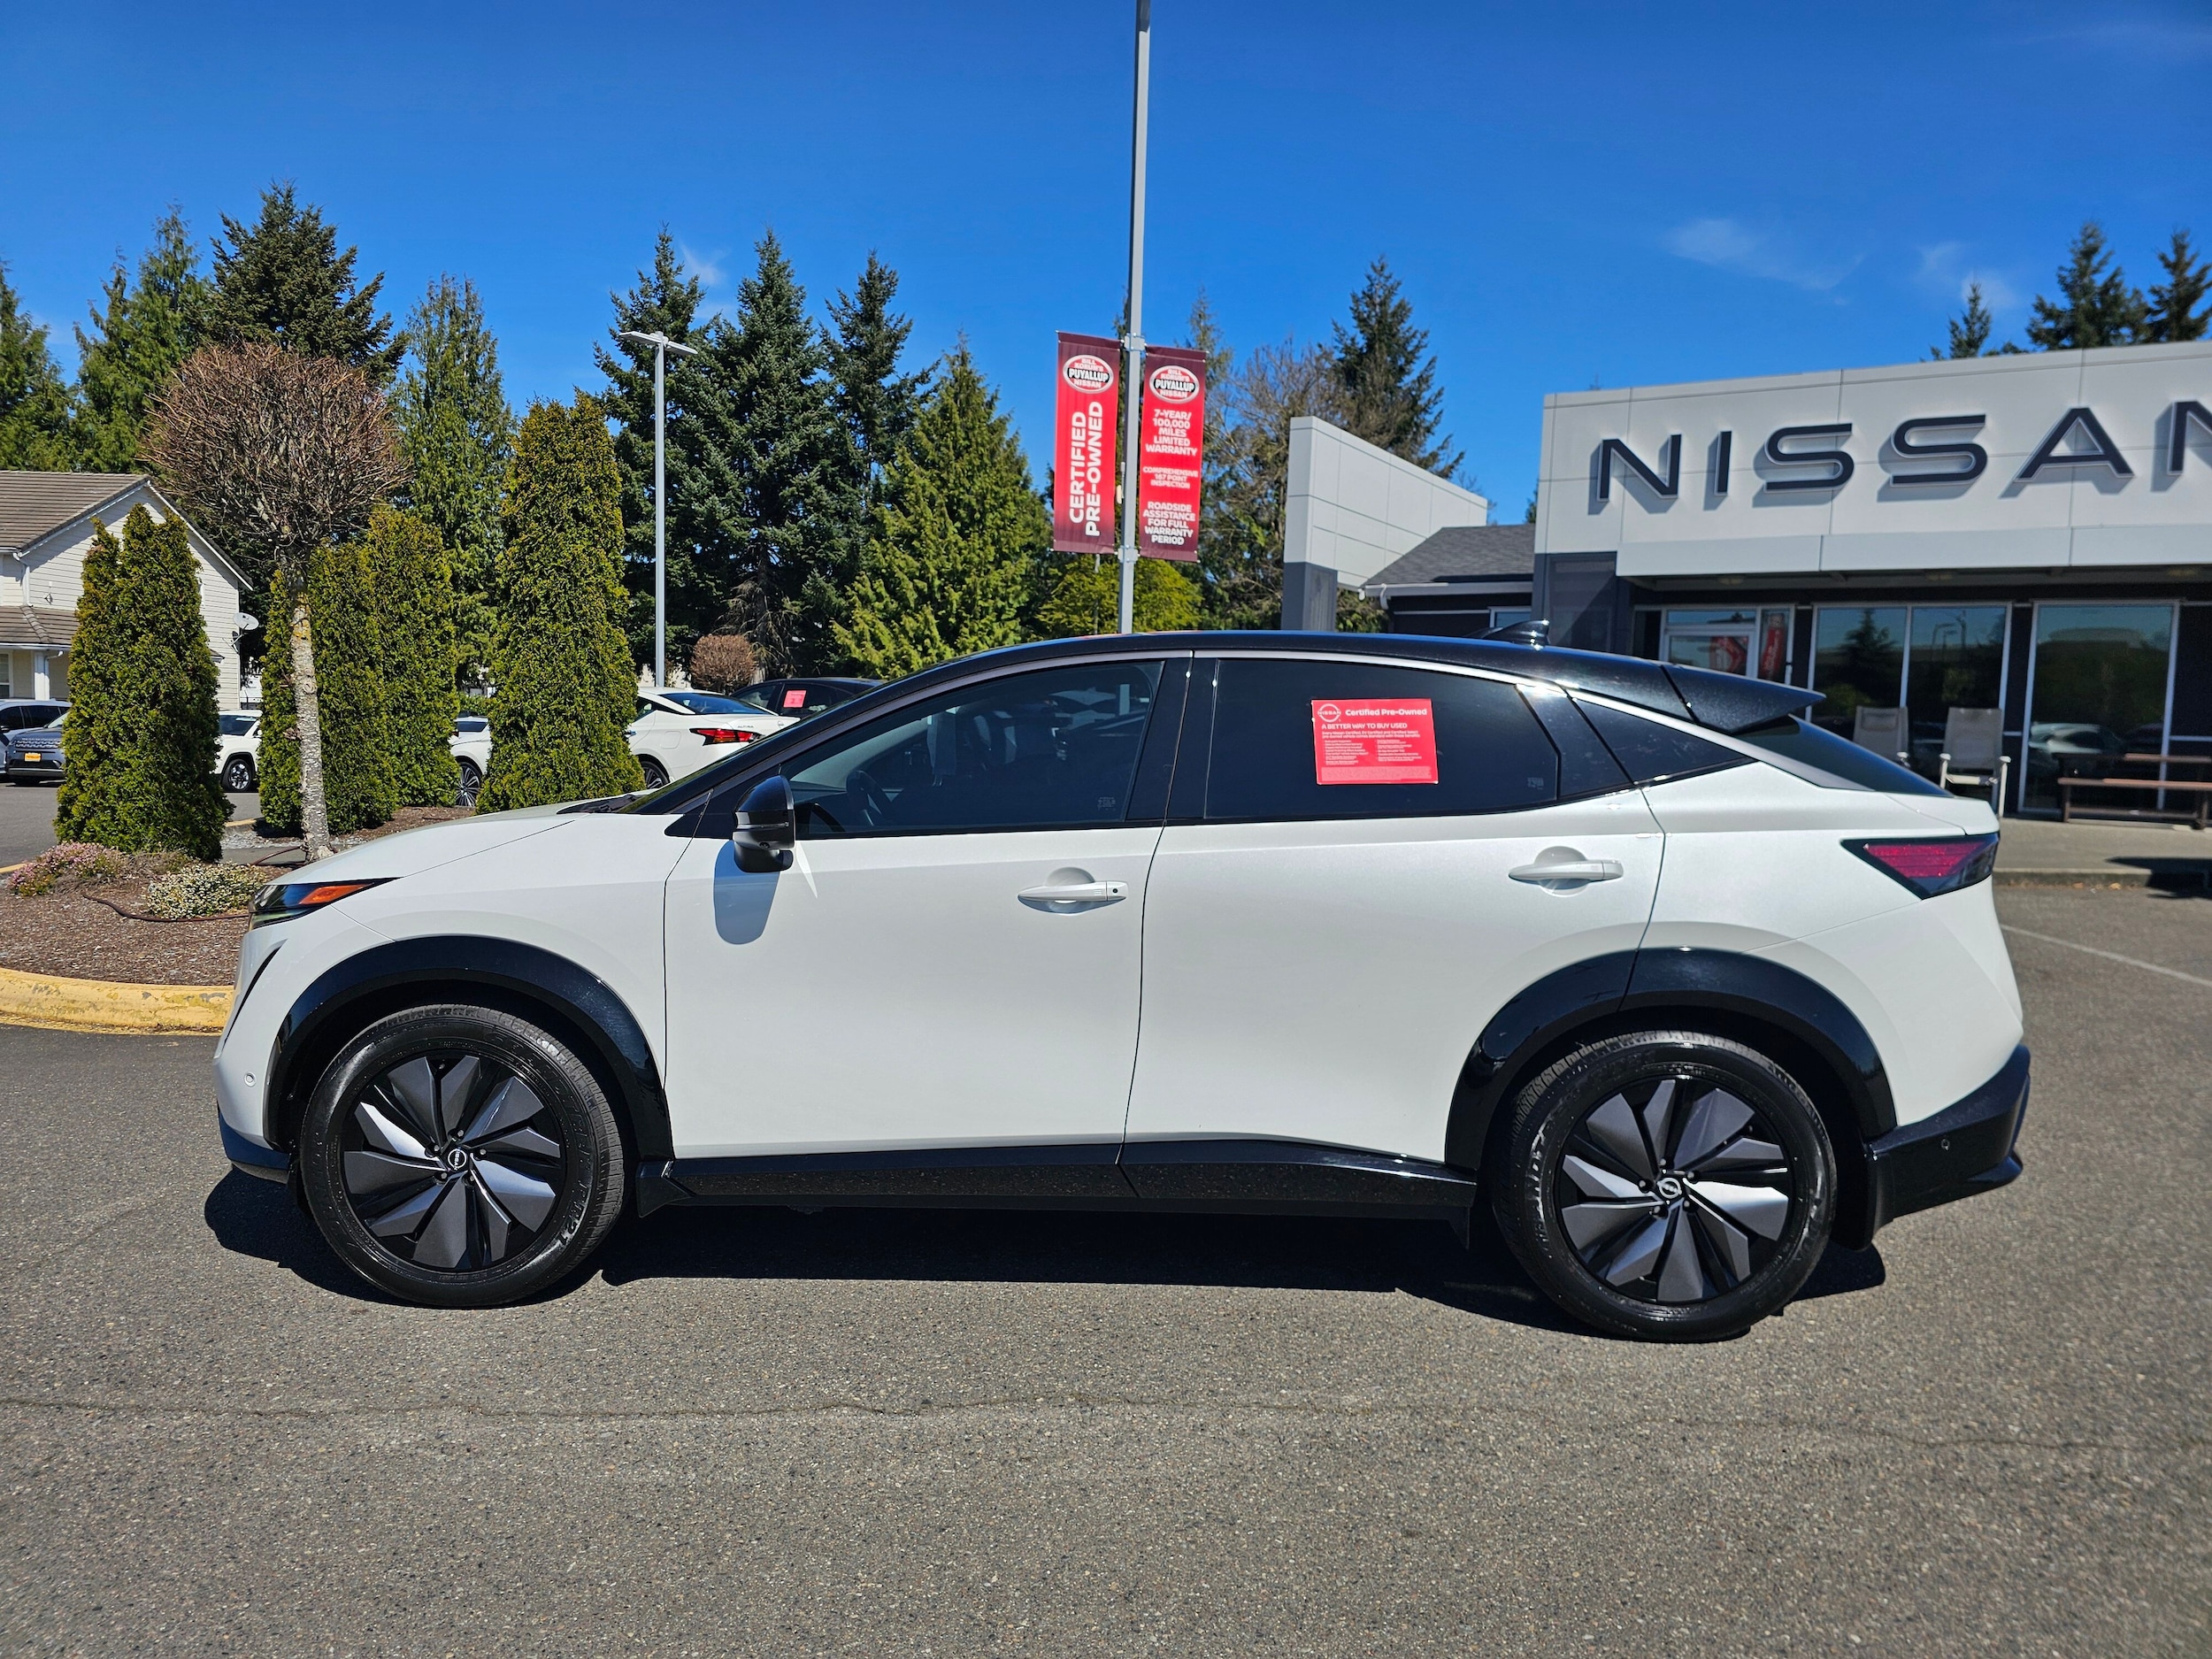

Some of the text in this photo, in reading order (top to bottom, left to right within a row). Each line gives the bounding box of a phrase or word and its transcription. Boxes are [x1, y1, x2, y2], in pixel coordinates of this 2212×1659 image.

[1069, 368, 1110, 382] PUYALLUP
[1073, 379, 1102, 388] NISSAN
[1155, 380, 1194, 393] PUYALLUP
[1160, 389, 1188, 398] NISSAN
[1154, 409, 1192, 420] 7-YEAR/
[1153, 418, 1191, 429] 100,000
[1158, 427, 1187, 437] MILES
[1154, 435, 1191, 447] LIMITED
[1145, 443, 1198, 457] WARRANTY
[1070, 411, 1087, 524] CERTIFIED
[1085, 401, 1103, 537] PRE-OWNED
[1142, 465, 1198, 478] COMPREHENSIVE
[1150, 480, 1190, 488] INSPECTION
[1148, 501, 1192, 513] ROADSIDE
[1142, 510, 1196, 521] ASSISTANCE
[1148, 518, 1189, 529] FOR FULL
[1145, 526, 1194, 538] WARRANTY
[1151, 534, 1185, 545] PERIOD
